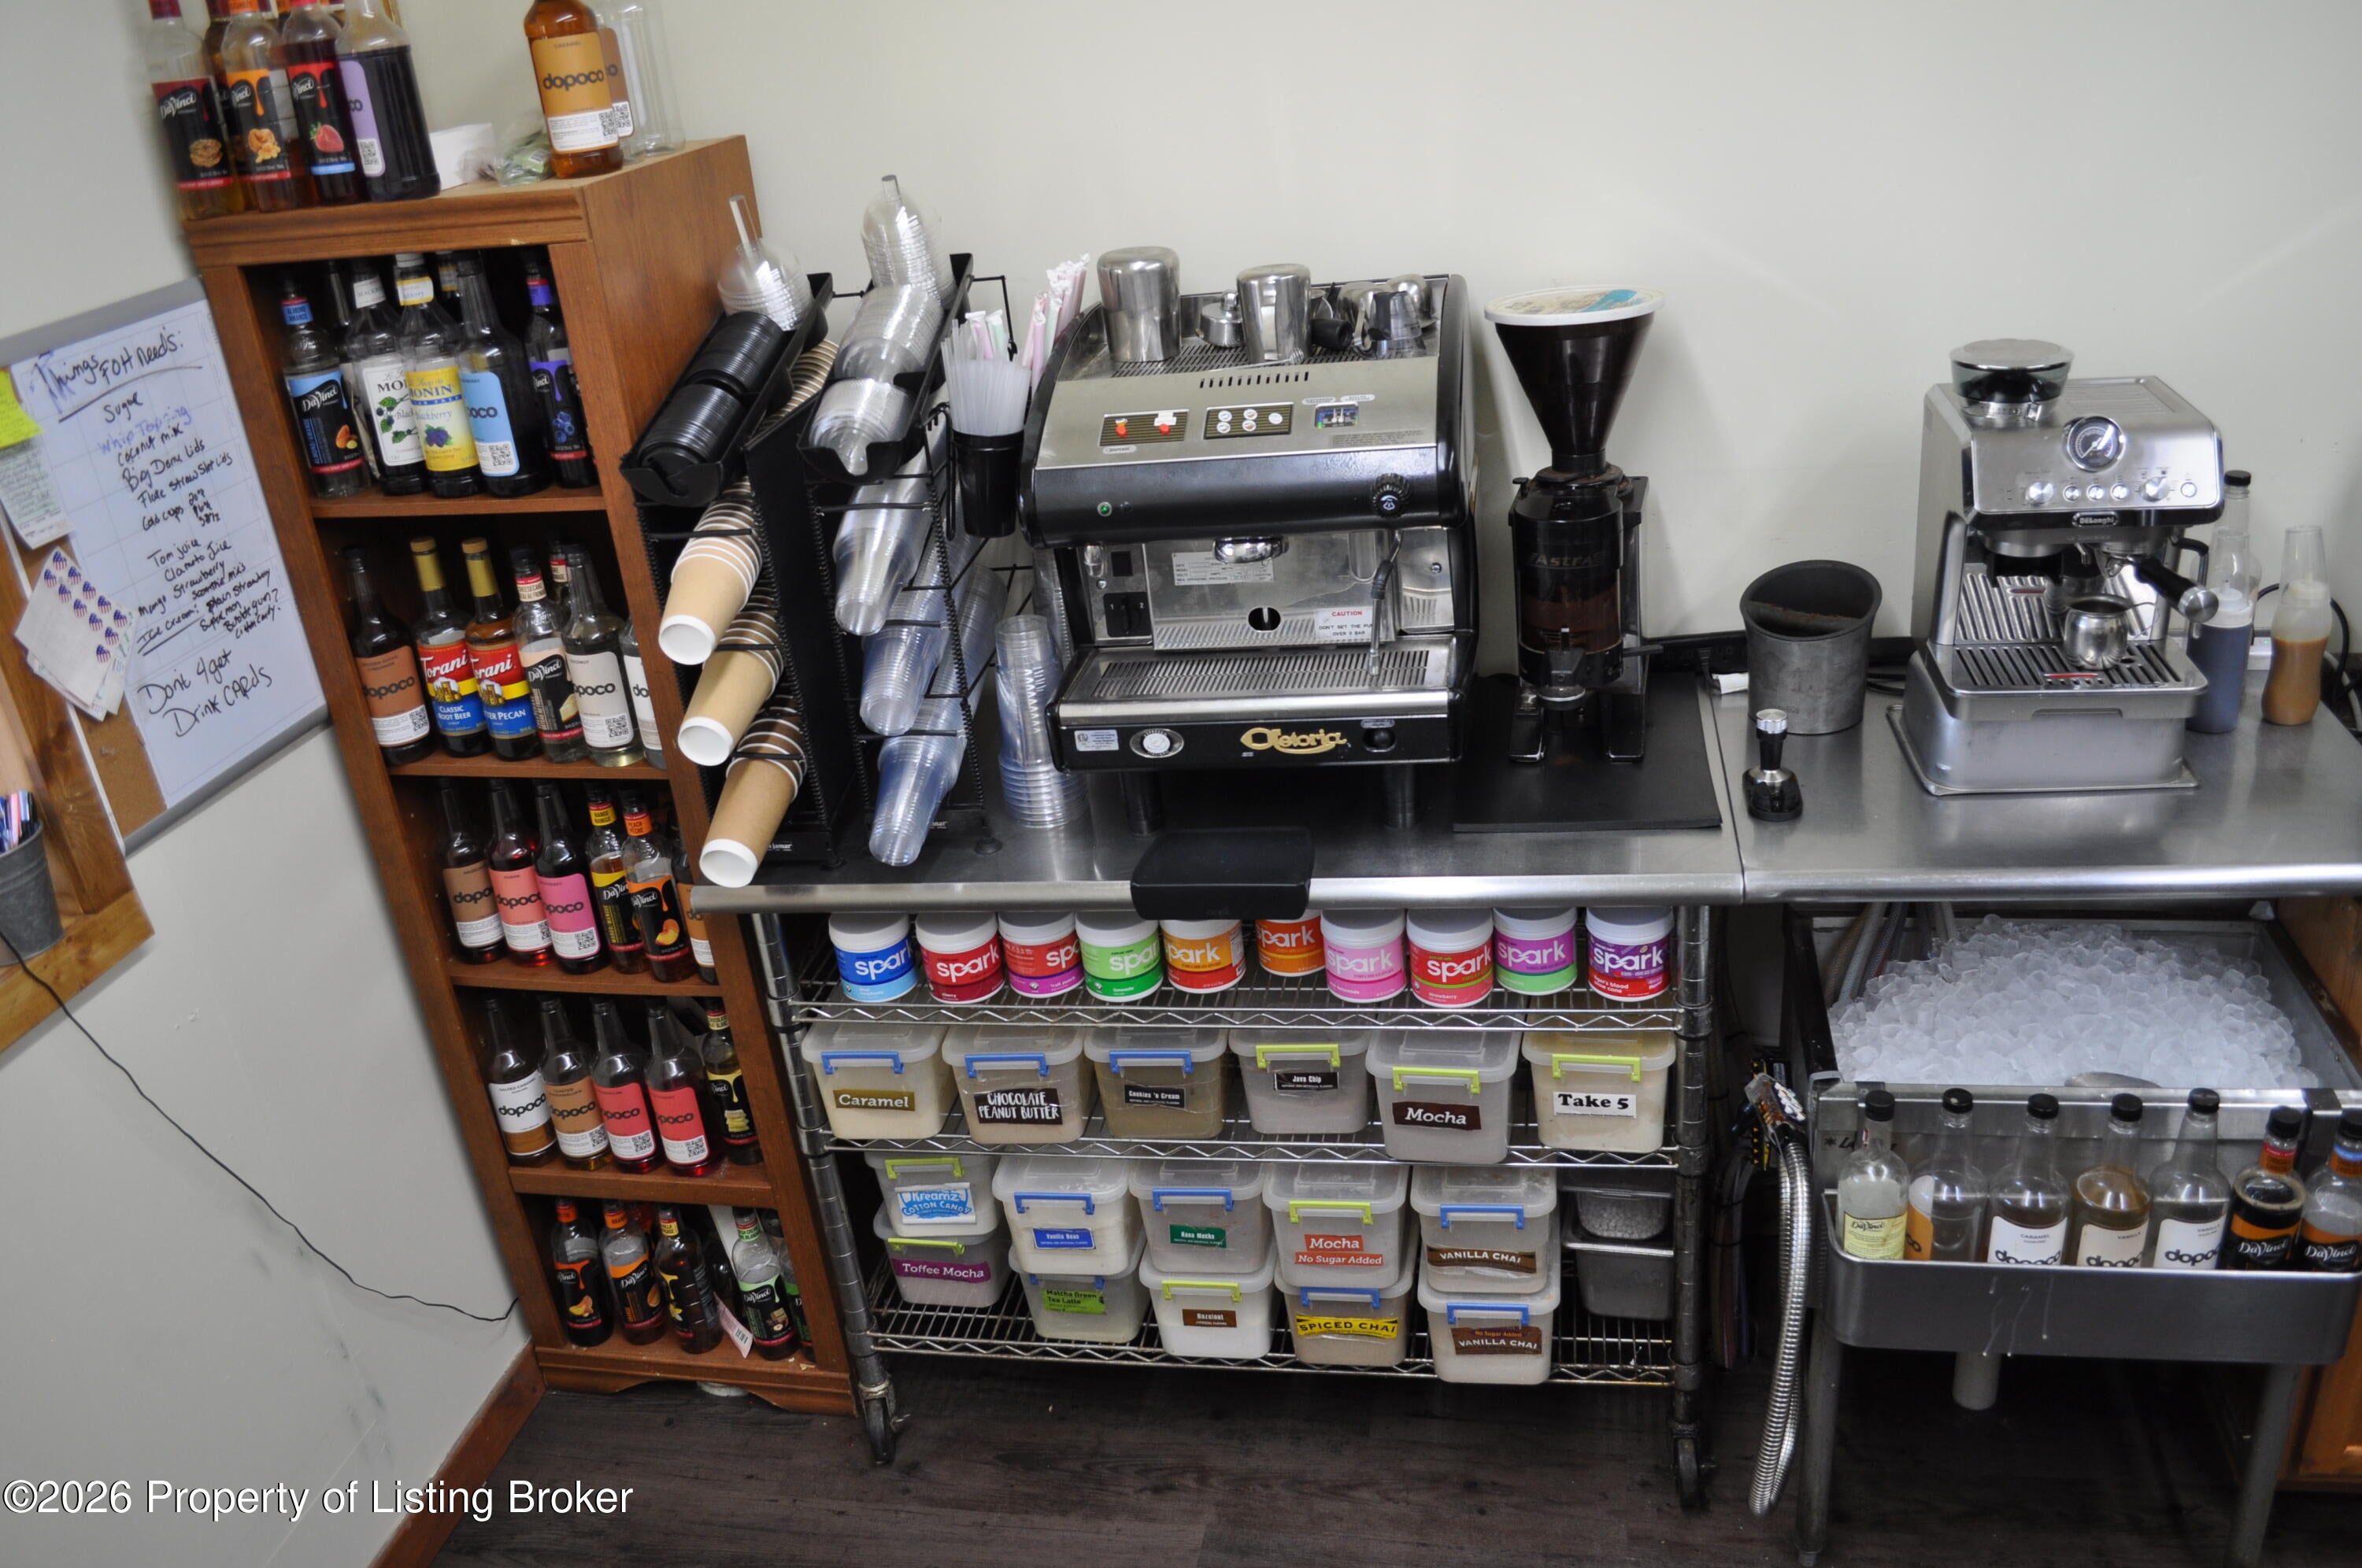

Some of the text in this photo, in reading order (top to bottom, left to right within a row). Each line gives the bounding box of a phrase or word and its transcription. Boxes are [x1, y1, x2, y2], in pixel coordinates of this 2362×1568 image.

[542, 69, 604, 91] dopoco
[231, 85, 251, 109] Vinci
[293, 77, 315, 101] Vinci
[160, 92, 197, 119] DaVinci
[533, 374, 550, 390] Vinci
[302, 385, 339, 412] DaVinci
[147, 549, 174, 568] Tom
[420, 649, 468, 681] Torani
[528, 660, 561, 682] DaVinci
[573, 682, 616, 697] opoco
[484, 709, 527, 720] TTER PECAN
[454, 887, 492, 904] dopo
[603, 882, 628, 900] DaVin
[546, 901, 583, 914] poco
[1167, 943, 1220, 962] park
[1498, 941, 1566, 967] spark
[1594, 945, 1664, 973] spark
[936, 944, 999, 982] spark
[1327, 949, 1393, 974] spark
[1427, 945, 1491, 982] spark
[713, 1083, 729, 1093] Vinci
[1128, 1090, 1152, 1099] Cookies
[499, 1093, 546, 1117] dopoco
[839, 1094, 909, 1108] Caramel
[987, 1092, 1047, 1106] CHOCOLATE
[1558, 1093, 1629, 1109] Take 5
[604, 1108, 640, 1119] poco
[657, 1113, 694, 1124] poco
[978, 1105, 1060, 1119] PEANUT BUTTER
[1405, 1108, 1467, 1125] Mocha
[903, 1202, 936, 1215] COTTON
[1851, 1221, 1885, 1232] DaVinci
[1309, 1237, 1360, 1248] Mocha
[2238, 1240, 2286, 1256] DaVinci
[1316, 1256, 1346, 1265] Sugar
[1440, 1250, 1521, 1263] VANILLA CHAI
[2305, 1244, 2356, 1261] DaVinci
[558, 1271, 576, 1282] Vinci
[620, 1265, 647, 1289] DaVinci
[902, 1263, 984, 1278] Toffee Mocha
[1300, 1322, 1397, 1333] SPICED CHAI
[1510, 1340, 1537, 1349] CHAI
